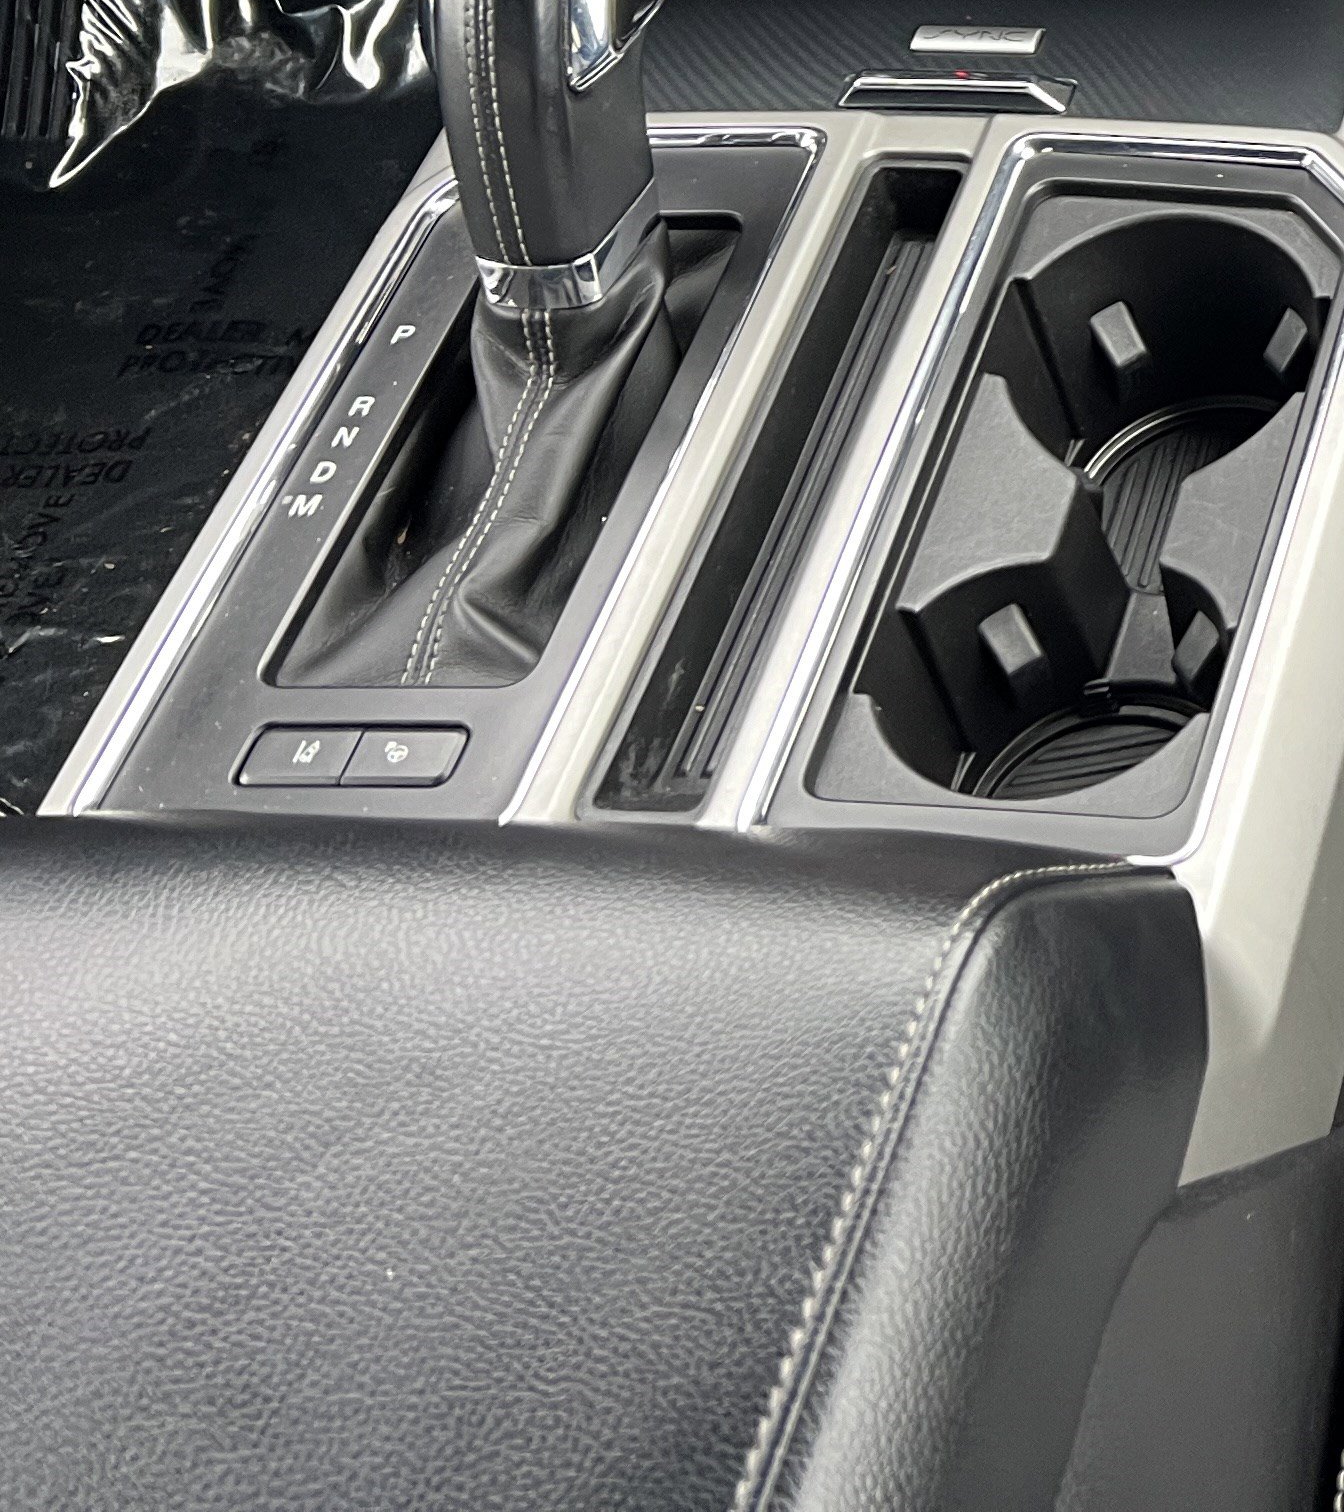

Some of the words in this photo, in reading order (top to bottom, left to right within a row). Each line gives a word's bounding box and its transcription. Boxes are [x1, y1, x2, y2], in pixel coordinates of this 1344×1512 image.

[391, 325, 418, 346] P
[348, 395, 376, 418] R
[331, 427, 361, 448] N
[309, 462, 338, 483] D
[289, 495, 322, 517] M
